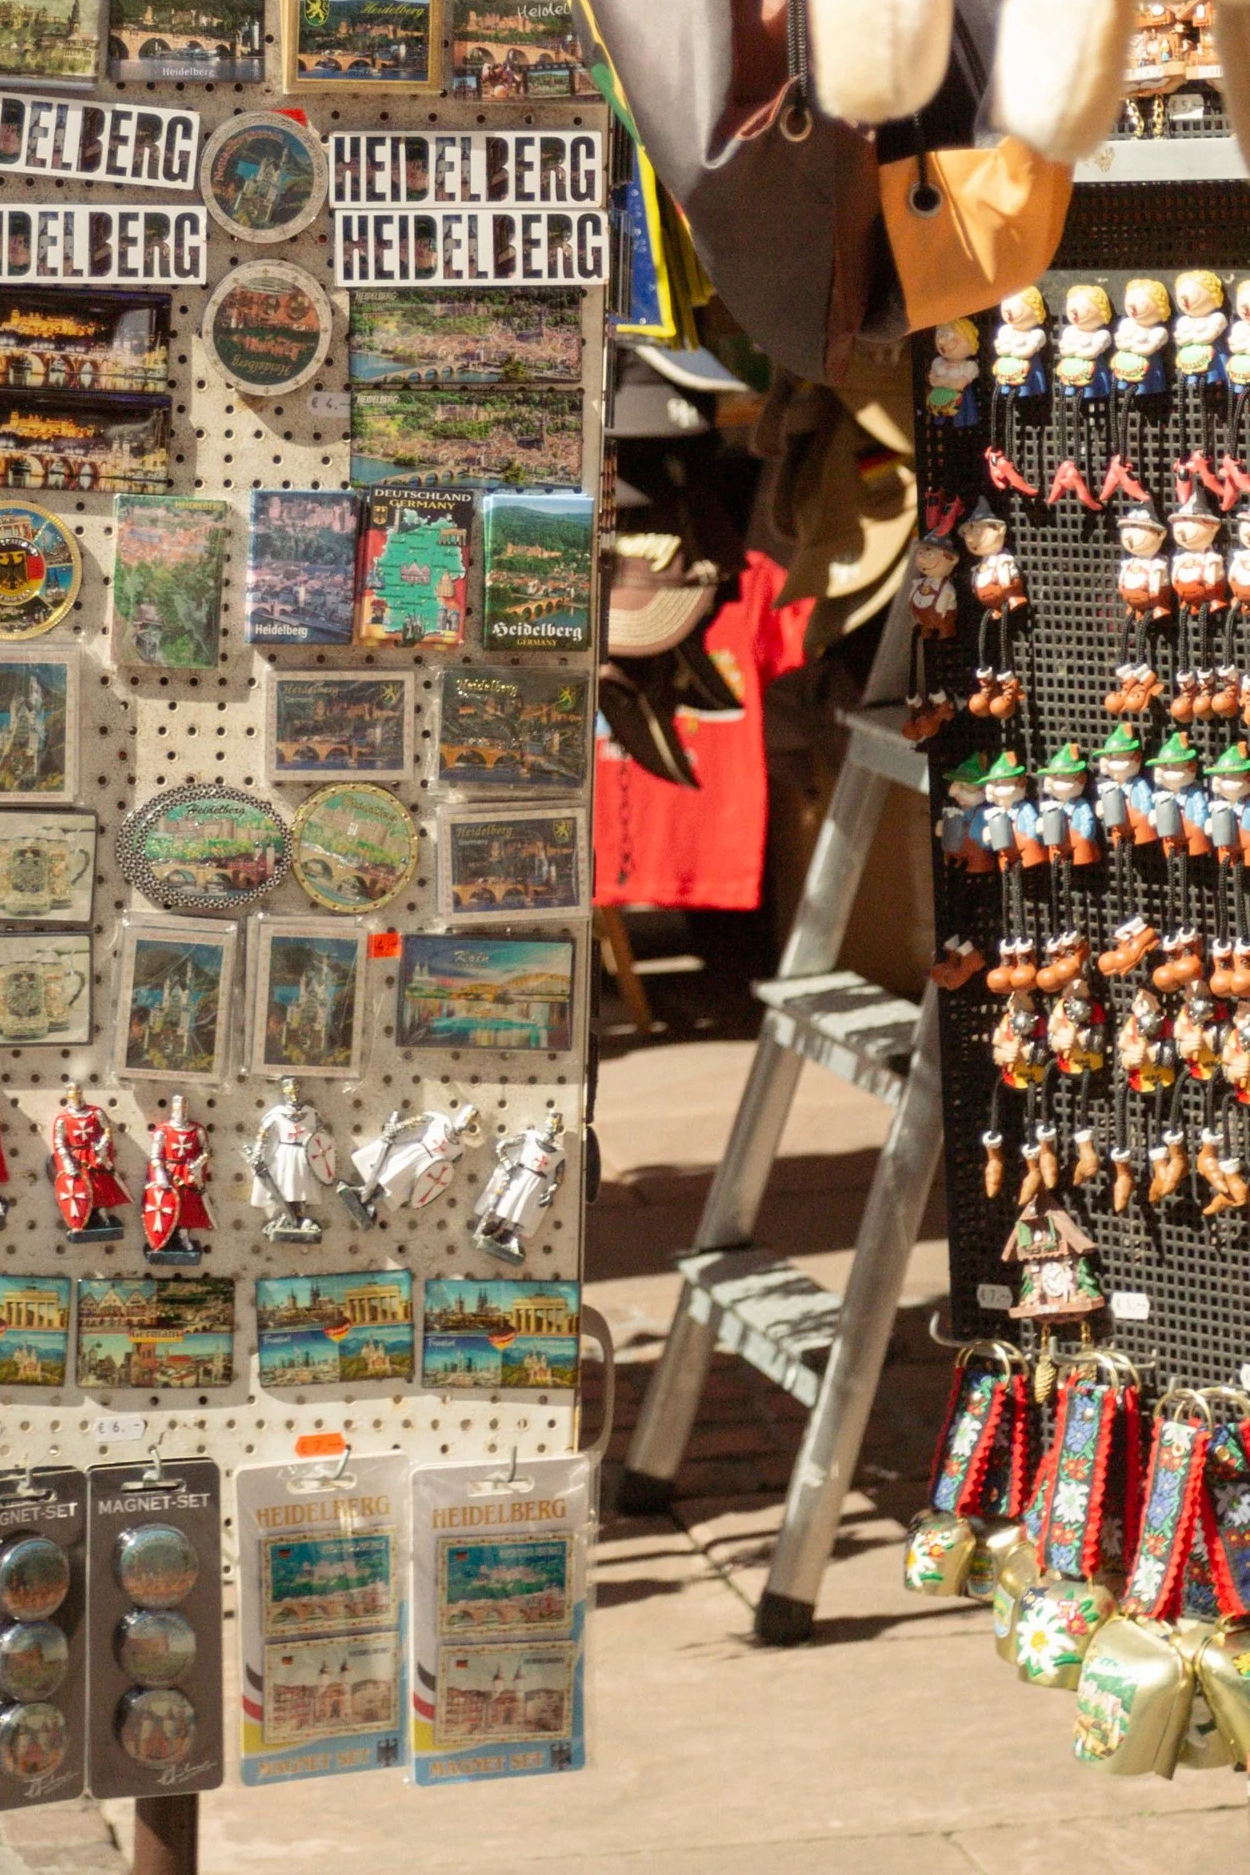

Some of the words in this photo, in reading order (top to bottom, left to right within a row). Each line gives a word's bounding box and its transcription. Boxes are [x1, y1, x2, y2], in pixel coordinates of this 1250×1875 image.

[361, 2, 426, 19] Heidelberg
[517, 3, 571, 18] Heidel
[162, 67, 216, 77] Heidelberg
[334, 136, 596, 202] HEIDELBERG
[342, 213, 603, 281] HEIDELBERG
[354, 290, 398, 301] HEIDELBERG
[356, 394, 399, 405] HEIDELBERG
[374, 488, 472, 503] DEUTSCHLAND
[389, 498, 456, 511] GERMANY
[255, 623, 308, 639] Heidelberg
[491, 622, 582, 642] Heidelberg
[516, 638, 558, 647] GERMANY
[456, 678, 518, 698] Heidelberg
[187, 802, 246, 817] Heidelberg
[98, 1493, 211, 1514] MAGNET-SET
[256, 1495, 391, 1528] HEIDELBERG
[431, 1498, 567, 1530] HEIDELBERG
[257, 1753, 332, 1776] MAGNET
[335, 1748, 372, 1767] SET
[429, 1755, 504, 1777] MAGNET
[509, 1751, 545, 1770] SET
